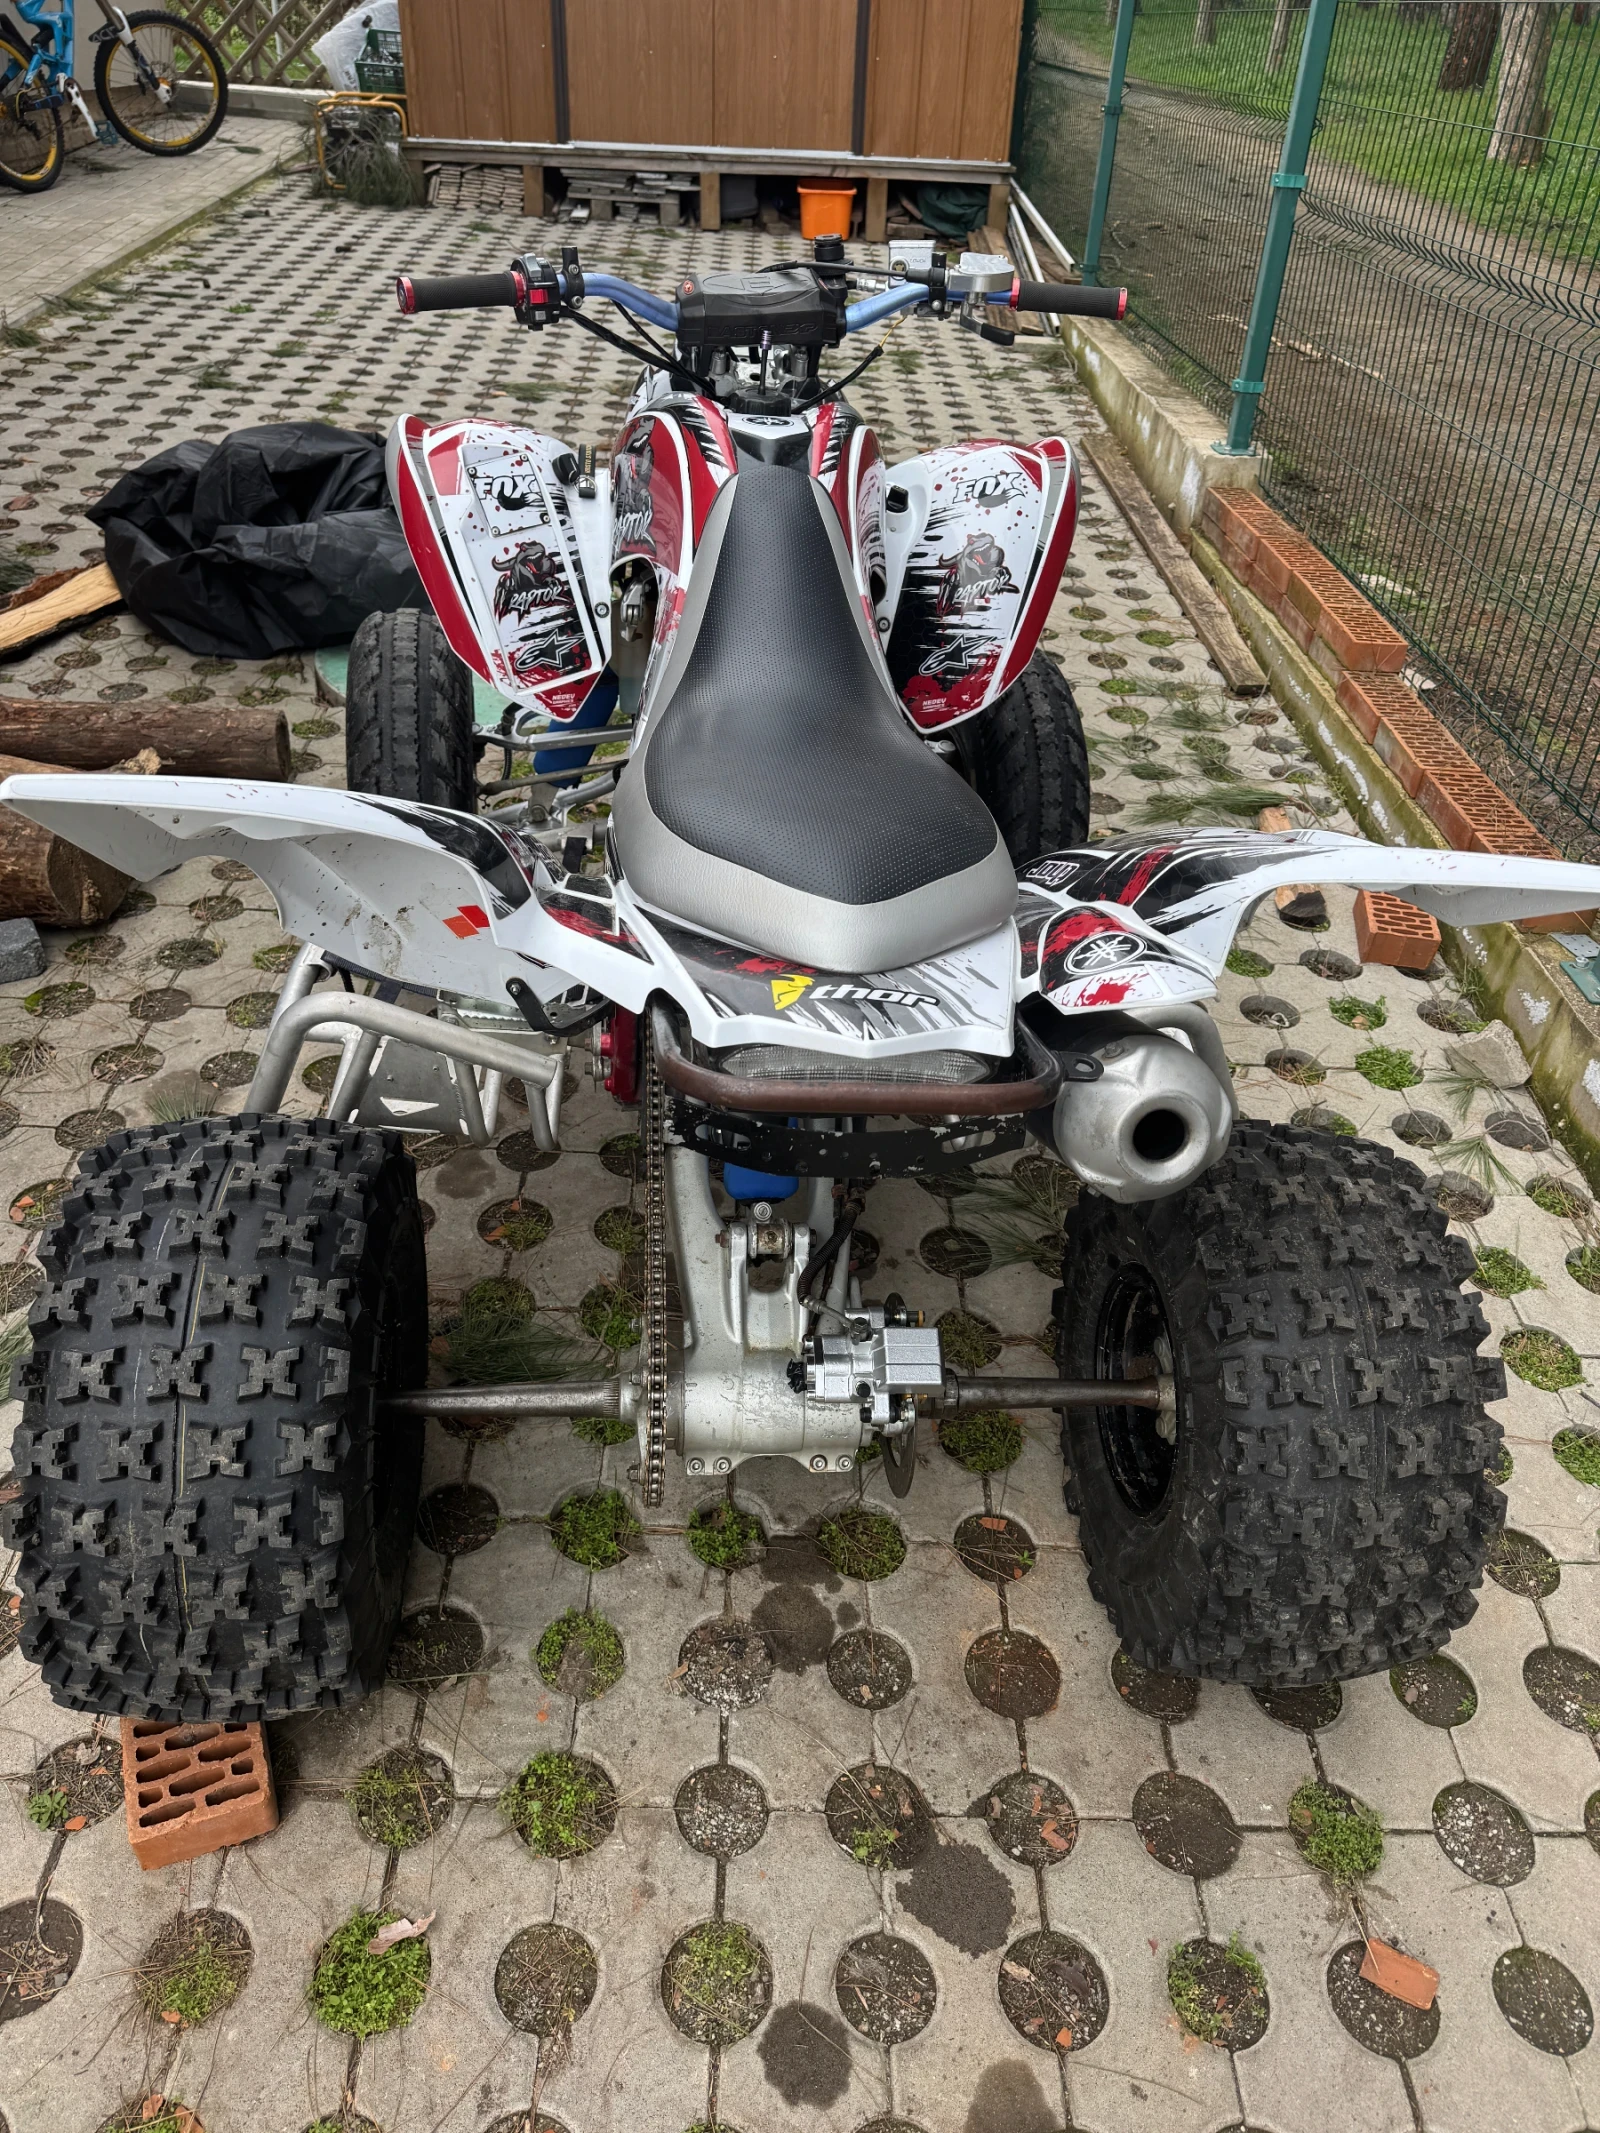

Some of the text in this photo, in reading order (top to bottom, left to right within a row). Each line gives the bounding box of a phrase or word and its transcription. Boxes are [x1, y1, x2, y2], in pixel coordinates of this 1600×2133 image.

[474, 474, 537, 503] FOX
[952, 472, 1023, 505] FOX
[509, 586, 570, 615] RAPTOR
[952, 575, 1015, 606] RAPTOR
[808, 984, 939, 1007] thor
